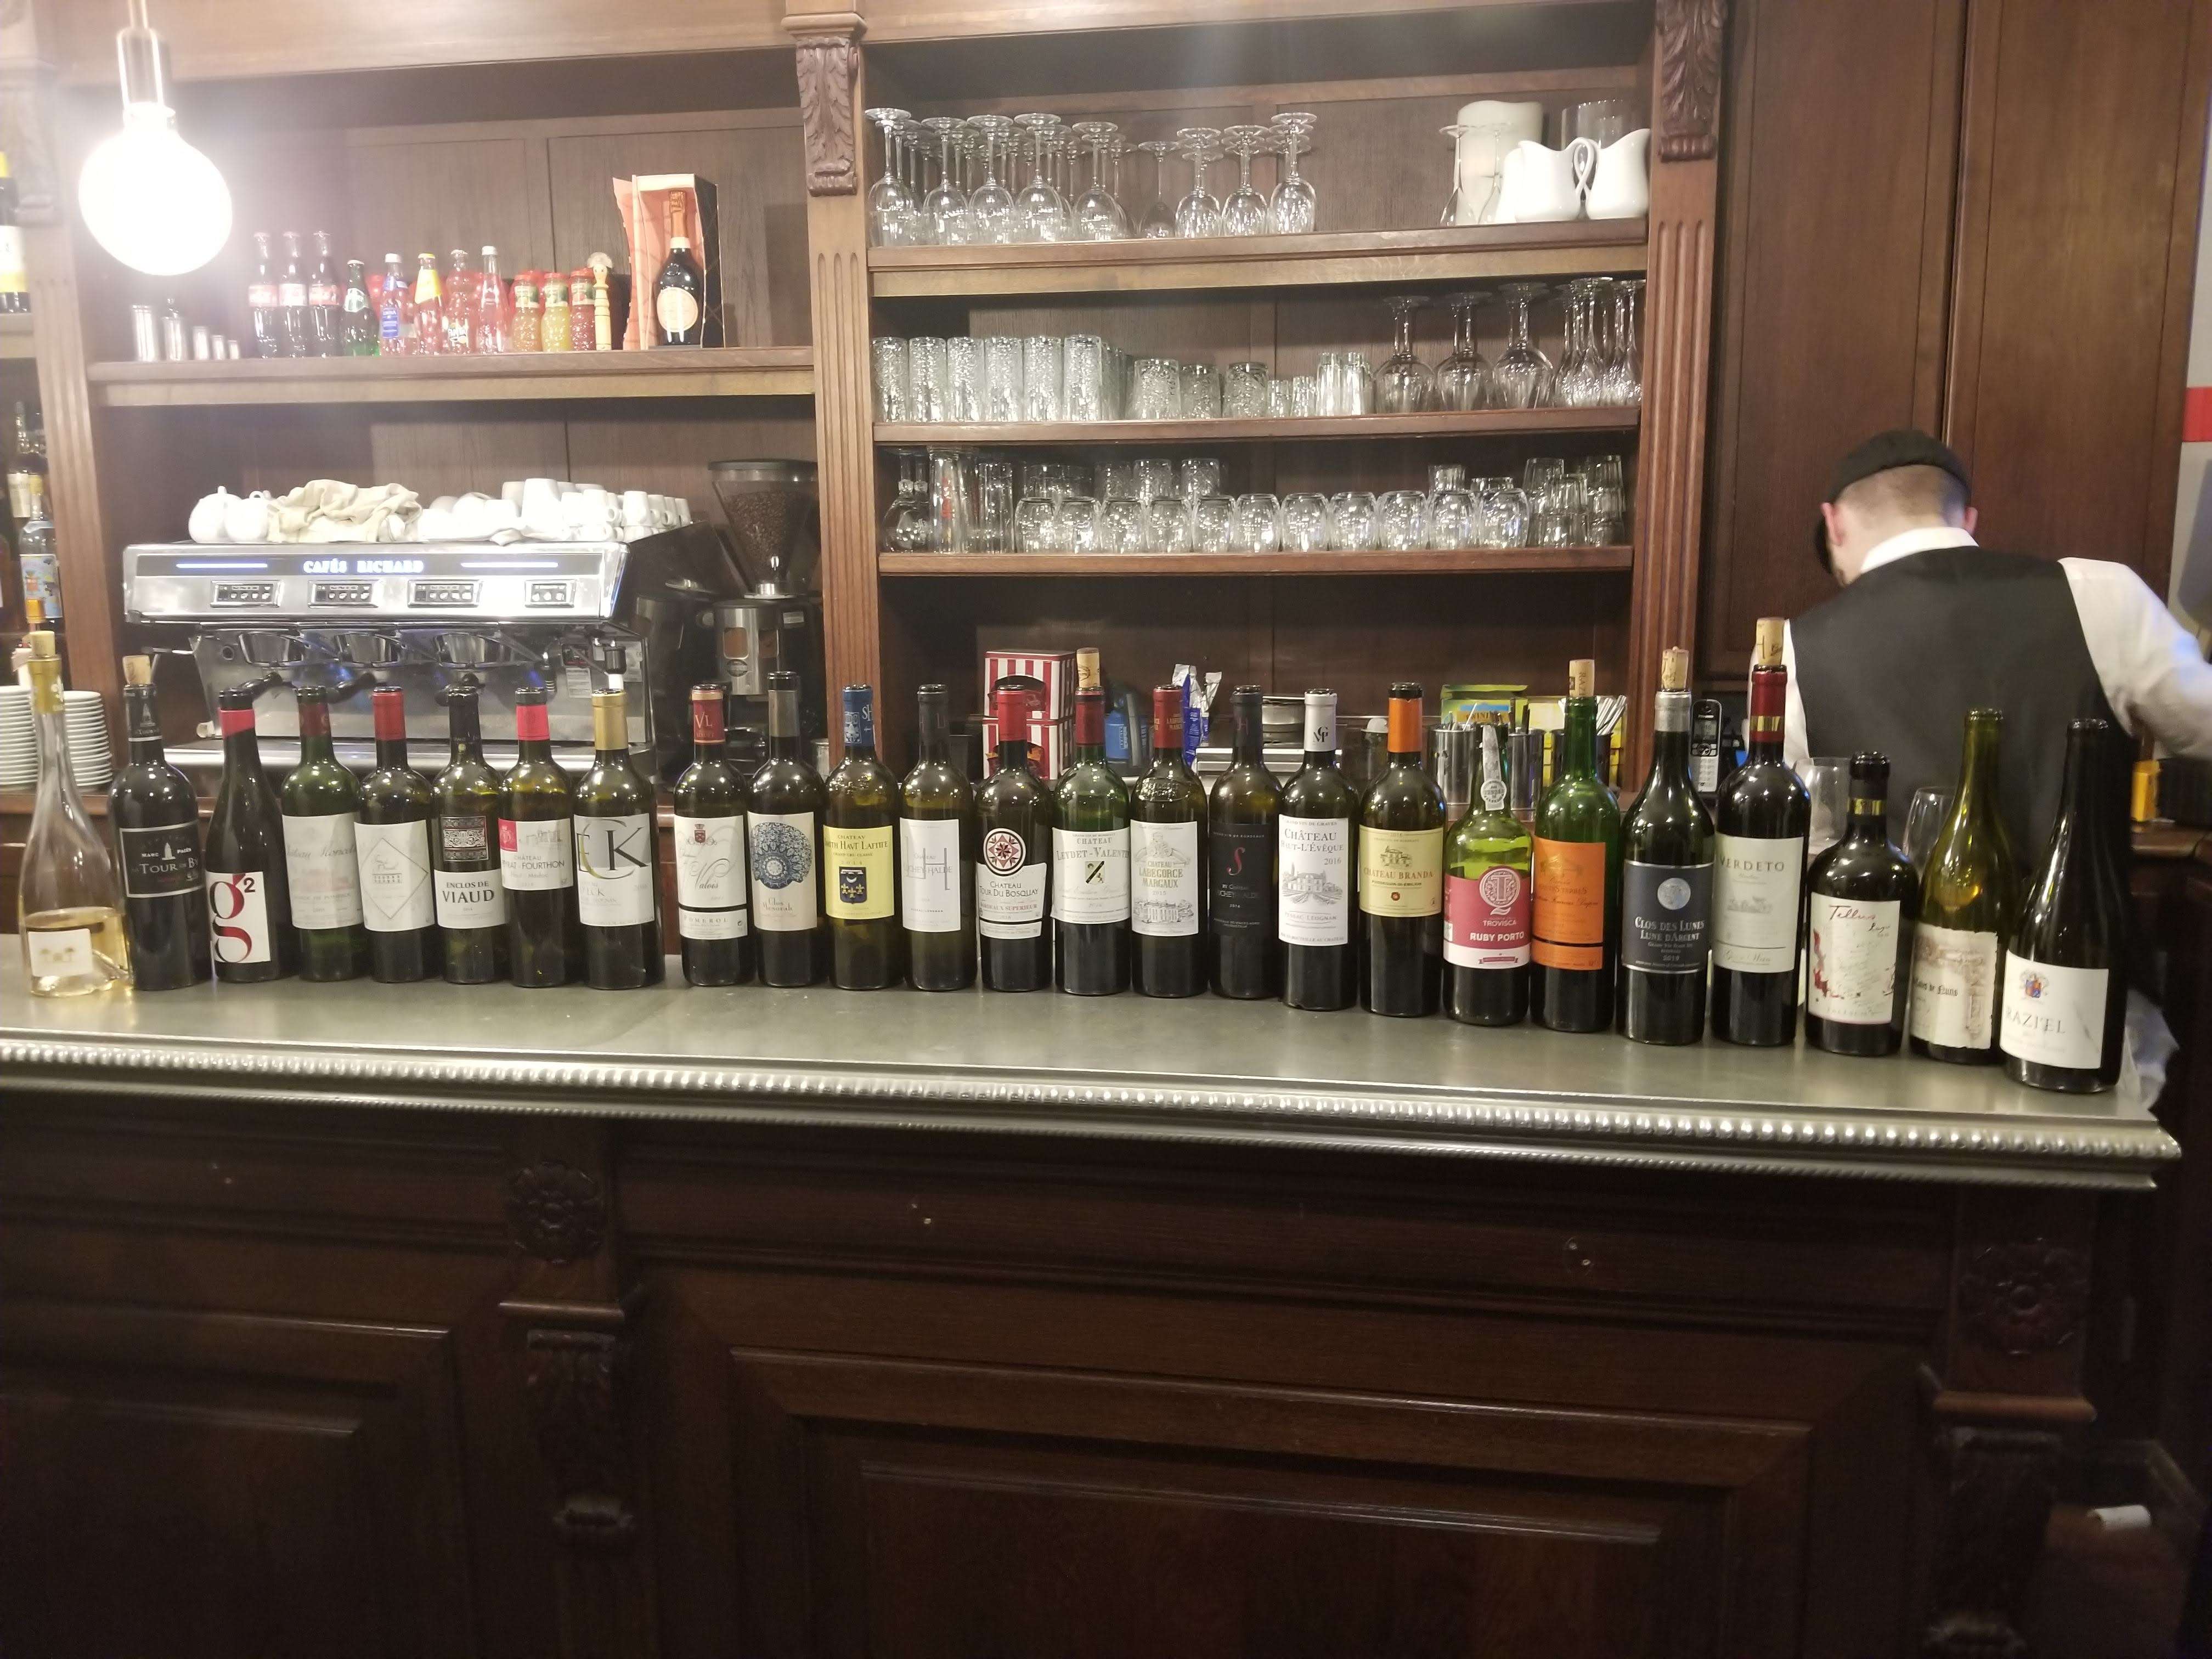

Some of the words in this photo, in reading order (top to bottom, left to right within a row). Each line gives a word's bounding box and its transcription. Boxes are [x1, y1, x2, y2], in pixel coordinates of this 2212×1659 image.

[357, 560, 424, 573] RICHARD
[1284, 828, 1337, 842] CHÂTEAU
[139, 863, 178, 874] TOUR
[1398, 871, 1434, 879] BRANDA
[1142, 879, 1178, 888] MARGAUX
[442, 889, 494, 904] VIAUD
[1006, 888, 1039, 898] BOSQUAY
[1634, 916, 1656, 930] CLOS
[1470, 932, 1495, 941] RUBY
[1497, 931, 1525, 941] PORTO
